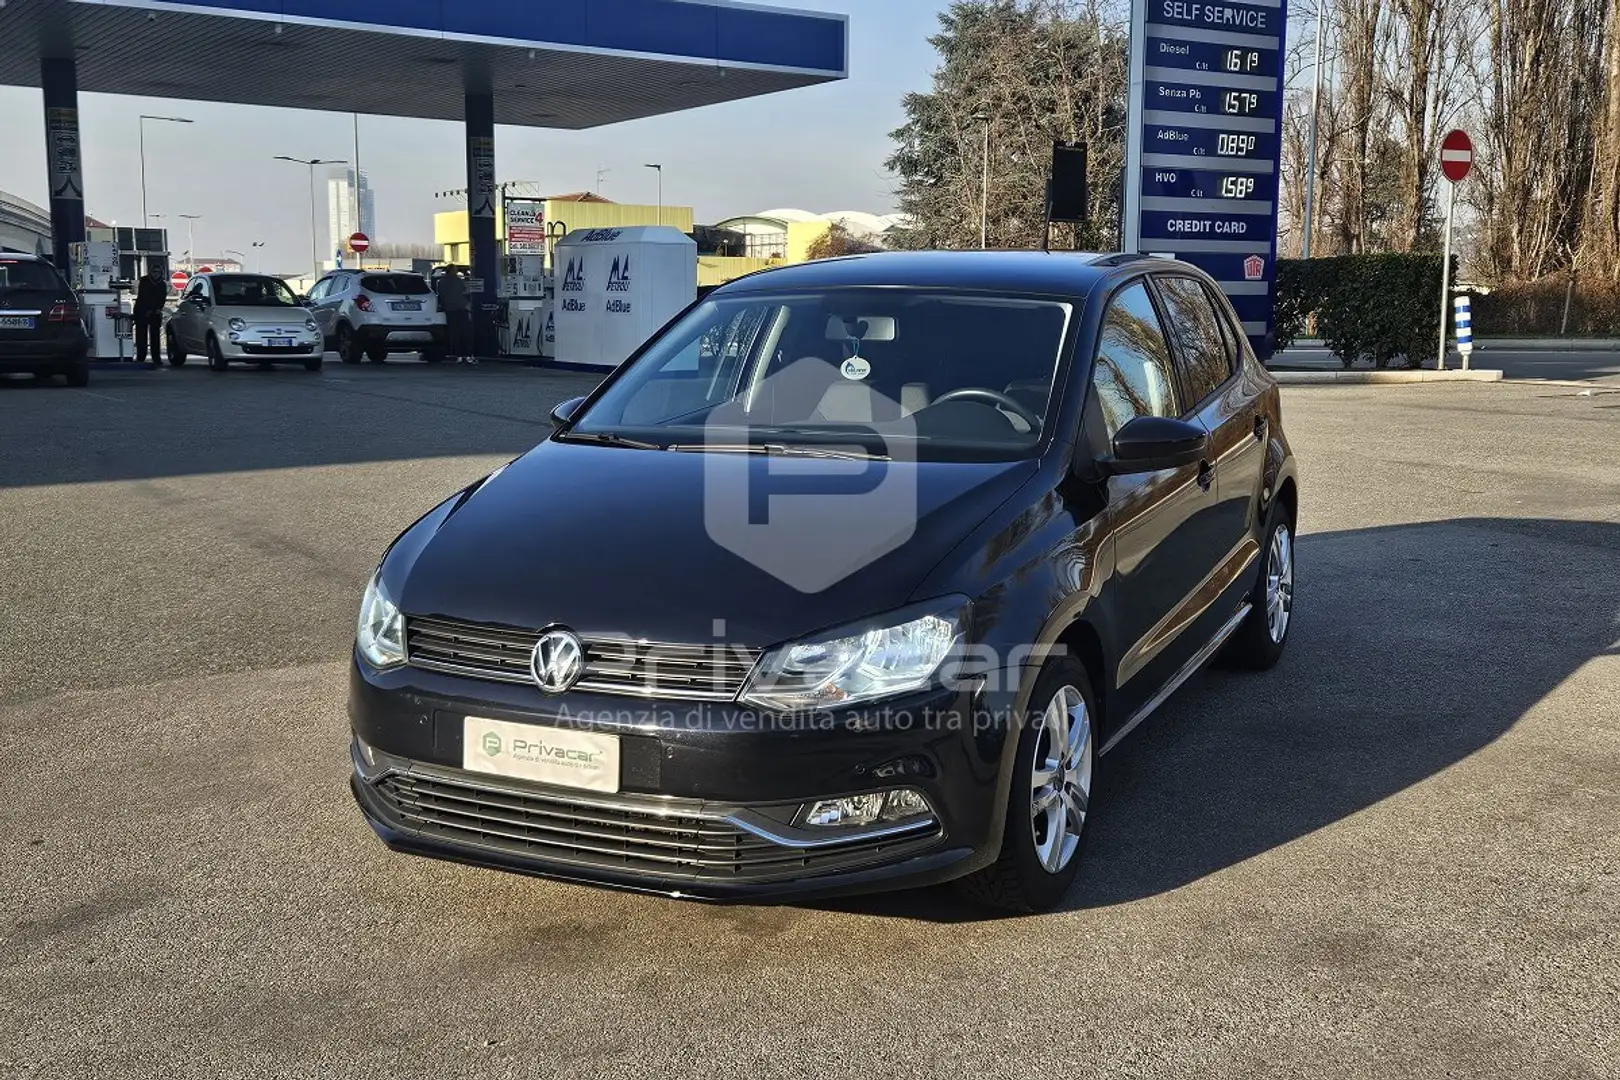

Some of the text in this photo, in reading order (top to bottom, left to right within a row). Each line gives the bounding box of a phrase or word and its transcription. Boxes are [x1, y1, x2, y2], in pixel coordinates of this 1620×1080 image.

[1163, 1, 1267, 28] SELF SERVICE
[1159, 43, 1189, 55] Diesel
[1158, 86, 1202, 99] Senza Pb
[1157, 129, 1189, 141] AdBlue
[1155, 172, 1177, 184] HVO
[535, 211, 544, 225] 4
[1167, 219, 1247, 234] CREDIT CARD
[580, 228, 623, 243] AdBlue
[561, 298, 586, 312] AdBlue
[606, 299, 631, 313] AdBlue
[513, 739, 604, 763] Privacar
